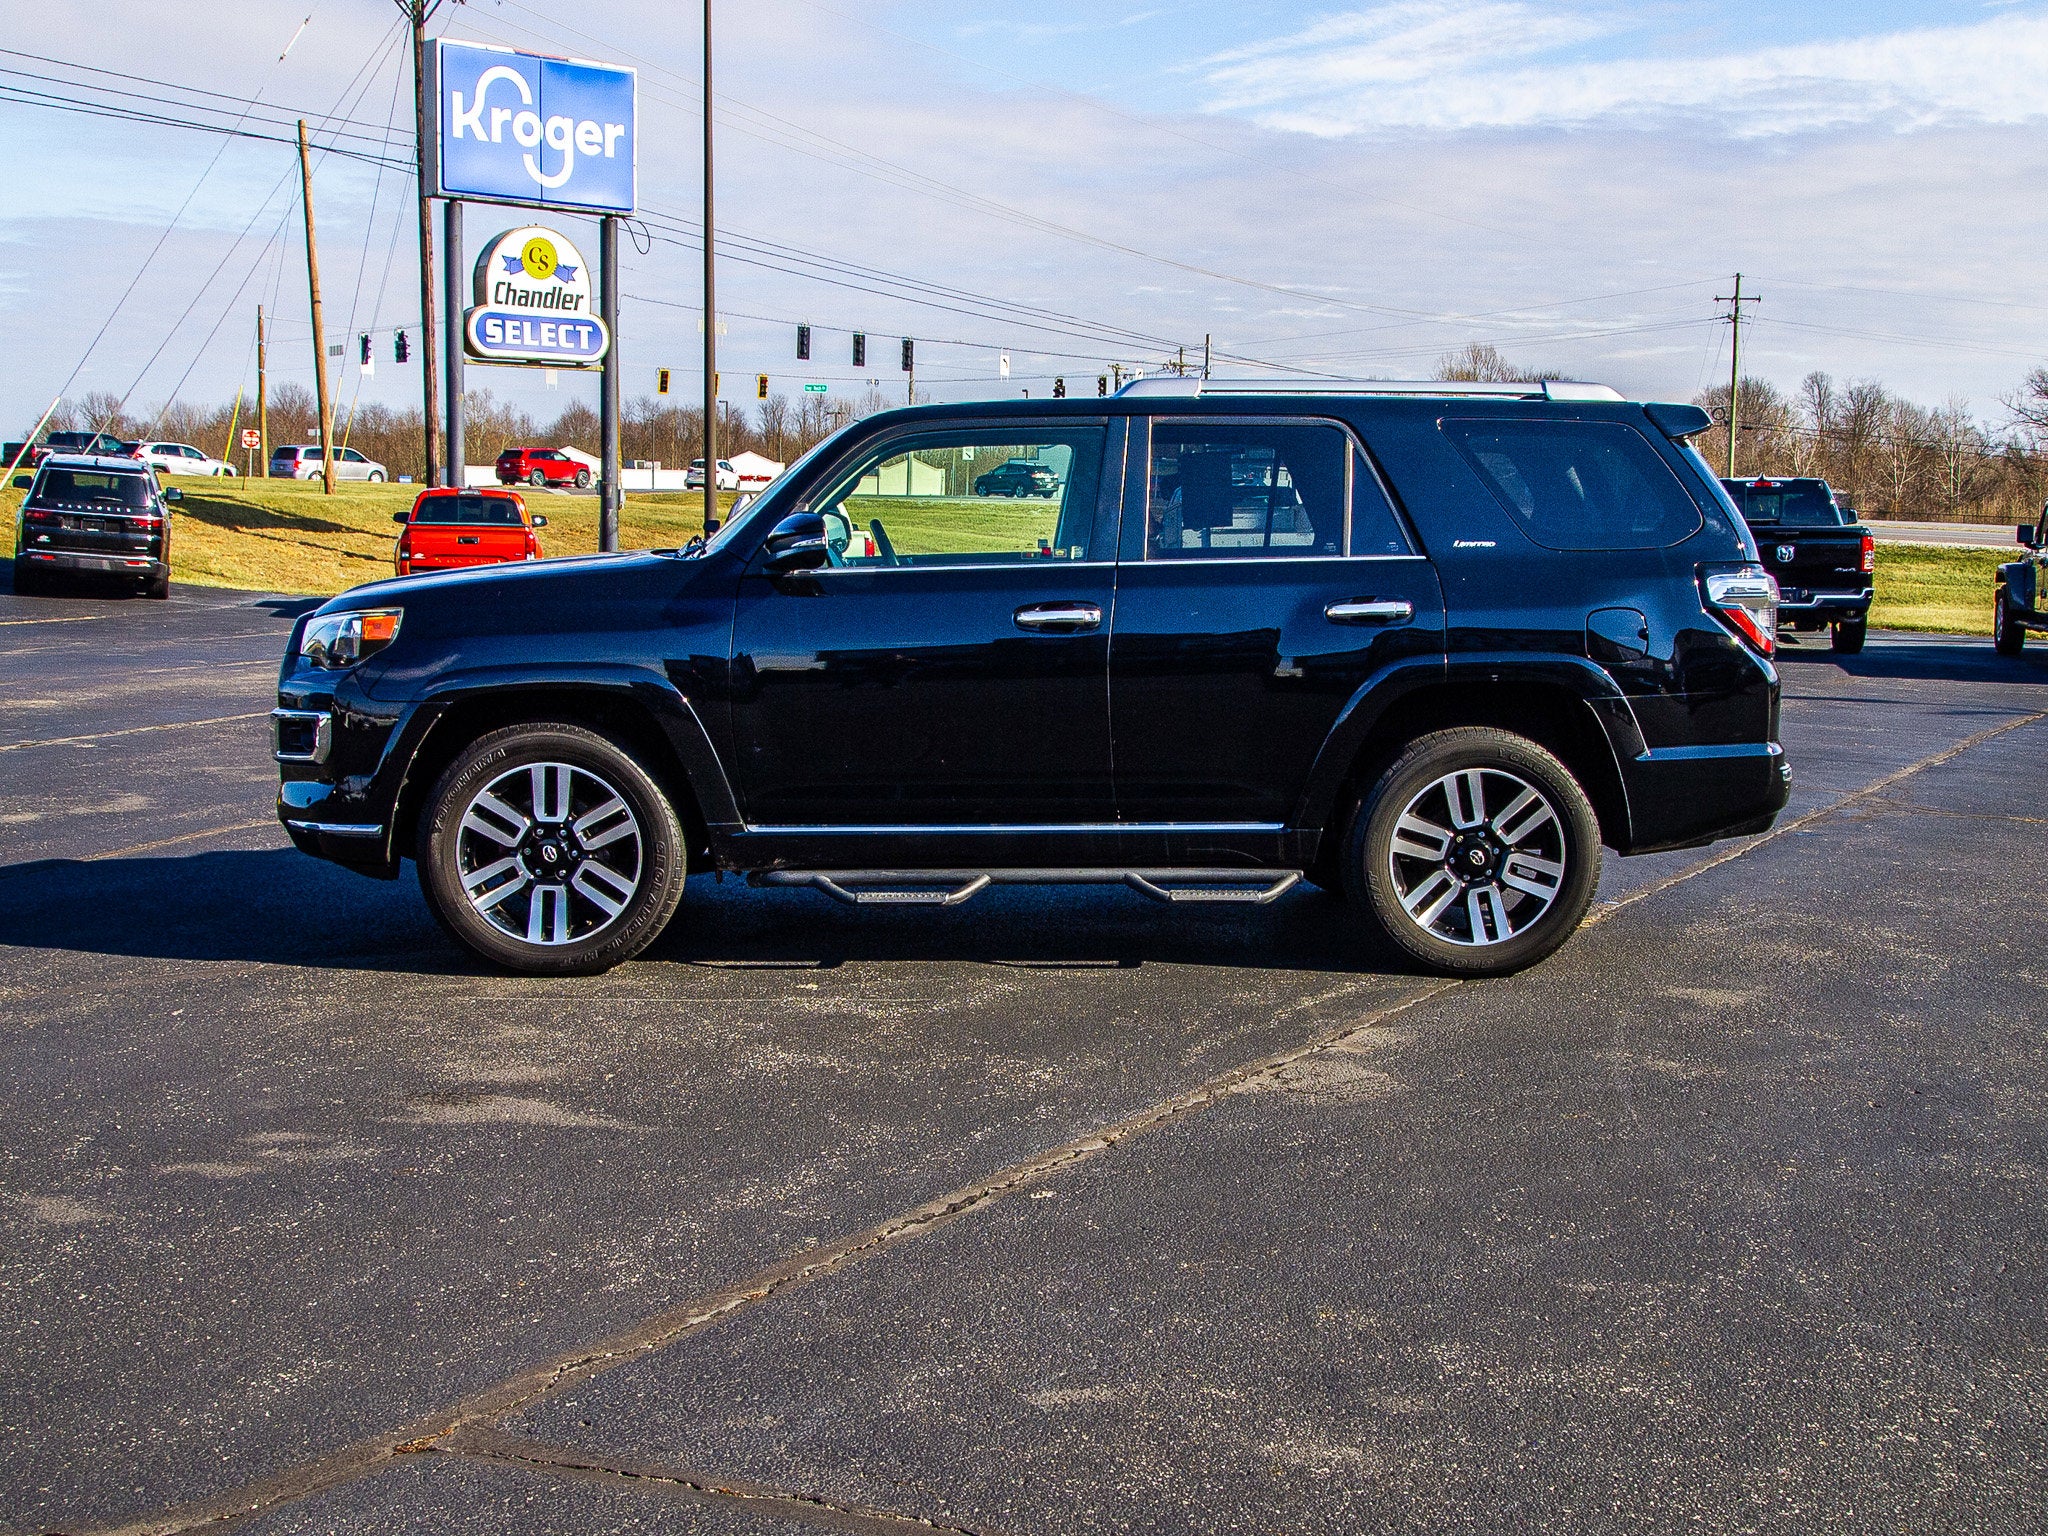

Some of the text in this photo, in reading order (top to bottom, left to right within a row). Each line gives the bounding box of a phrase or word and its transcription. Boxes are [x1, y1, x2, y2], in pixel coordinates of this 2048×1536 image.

[452, 65, 625, 189] Kroger
[494, 281, 584, 311] Chandler
[485, 318, 594, 350] SELECT
[432, 745, 506, 833] YOKOHAMA
[1499, 746, 1578, 816] YOKOHAMA
[1382, 911, 1494, 970] GEOLANDAR
